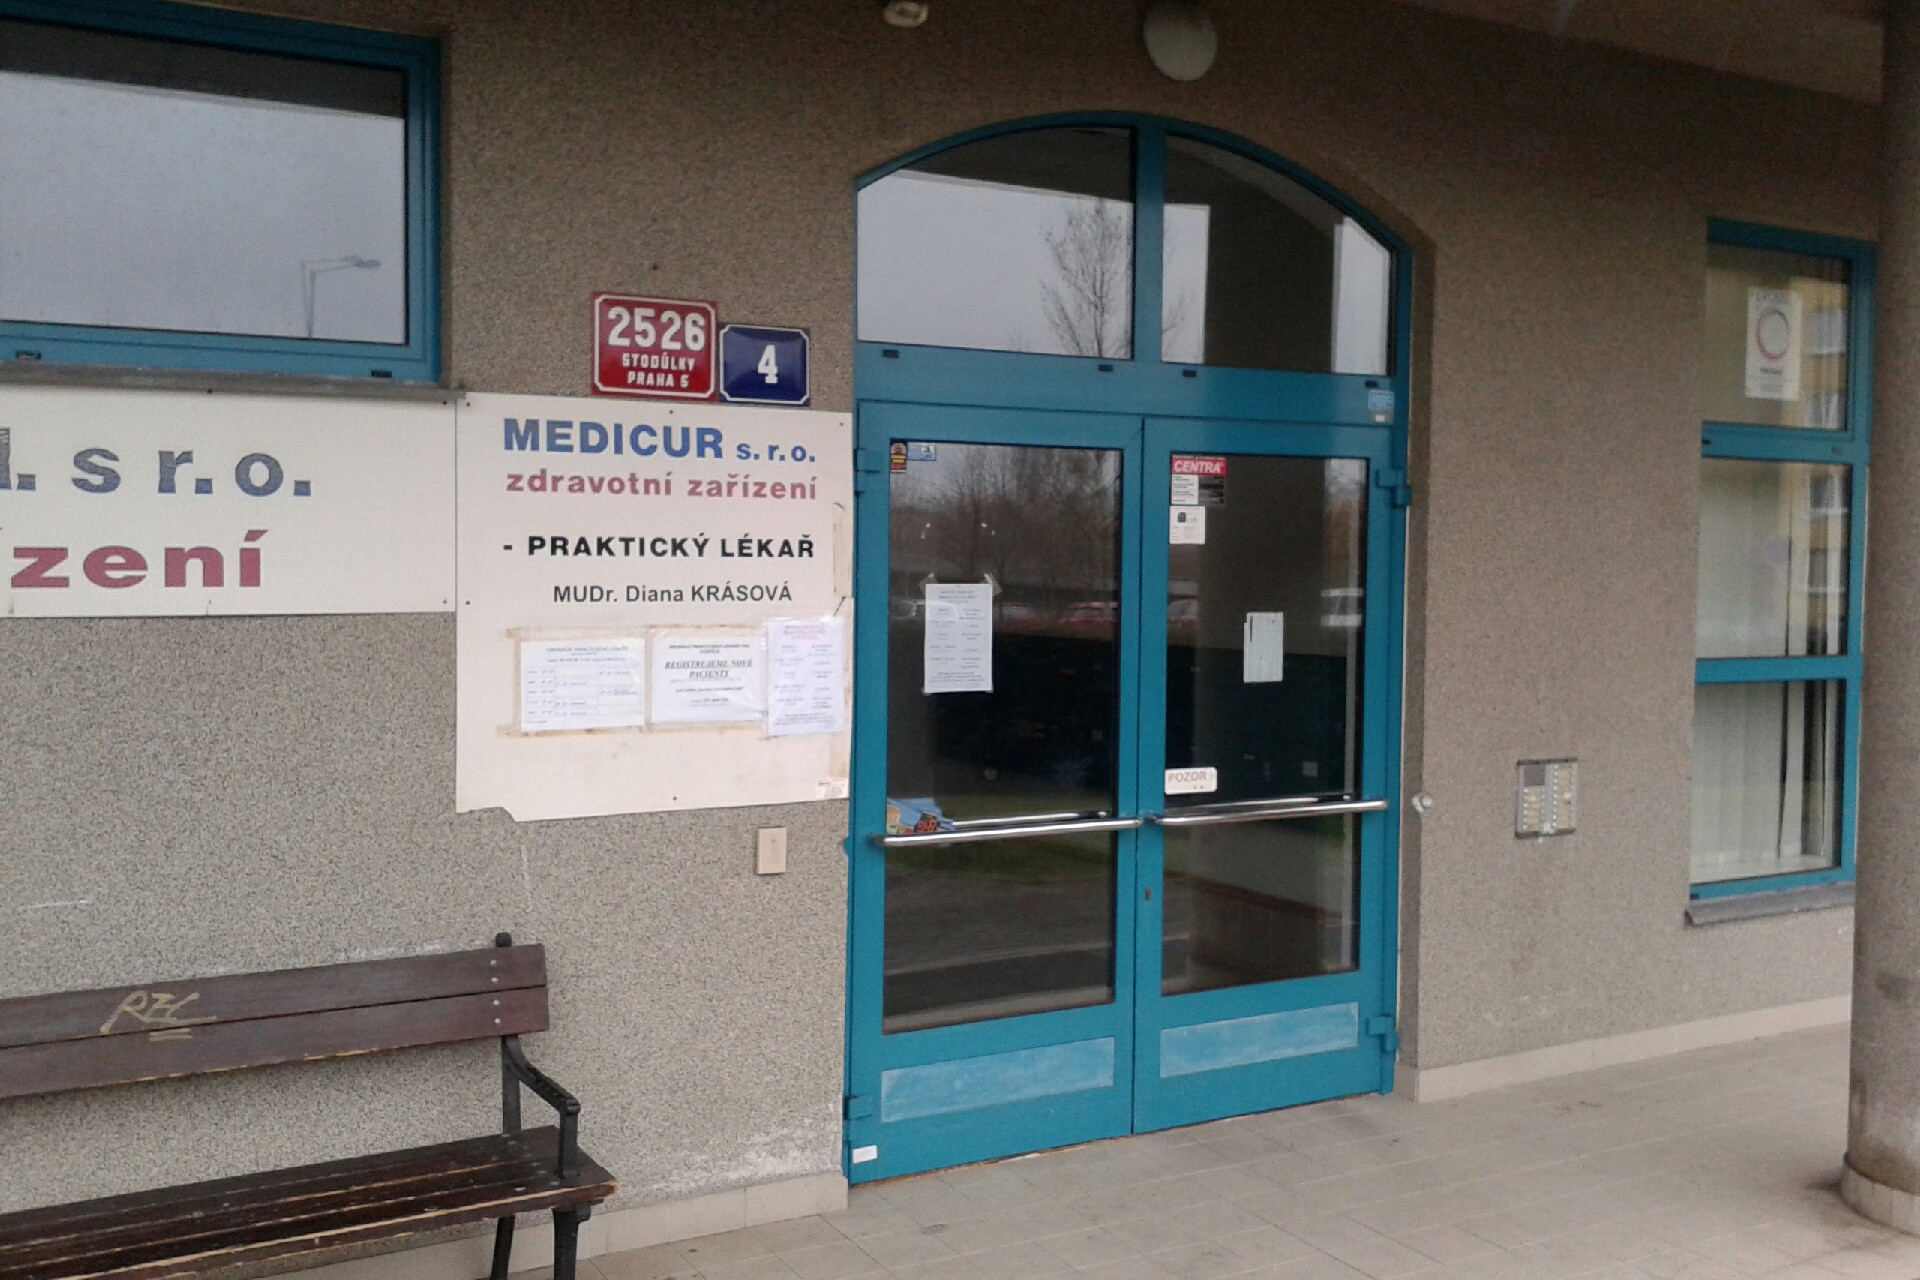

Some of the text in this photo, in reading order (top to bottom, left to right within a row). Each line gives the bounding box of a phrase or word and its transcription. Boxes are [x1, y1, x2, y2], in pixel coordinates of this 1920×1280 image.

[607, 306, 706, 352] 2526
[757, 344, 779, 384] 4
[627, 371, 674, 387] PRAHA
[503, 417, 816, 463] MEDICUR s.r.o.
[71, 447, 121, 494] s
[157, 449, 311, 498] r.o.
[1174, 460, 1221, 474] CENTRA
[506, 468, 817, 500] zdravotní zařízení
[528, 532, 710, 558] PRAKTICKÝ
[720, 534, 814, 559] LÉKAŘ
[553, 580, 793, 603] MUDr. Diana KRÁSOVÁ
[1168, 771, 1207, 783] POZOR
